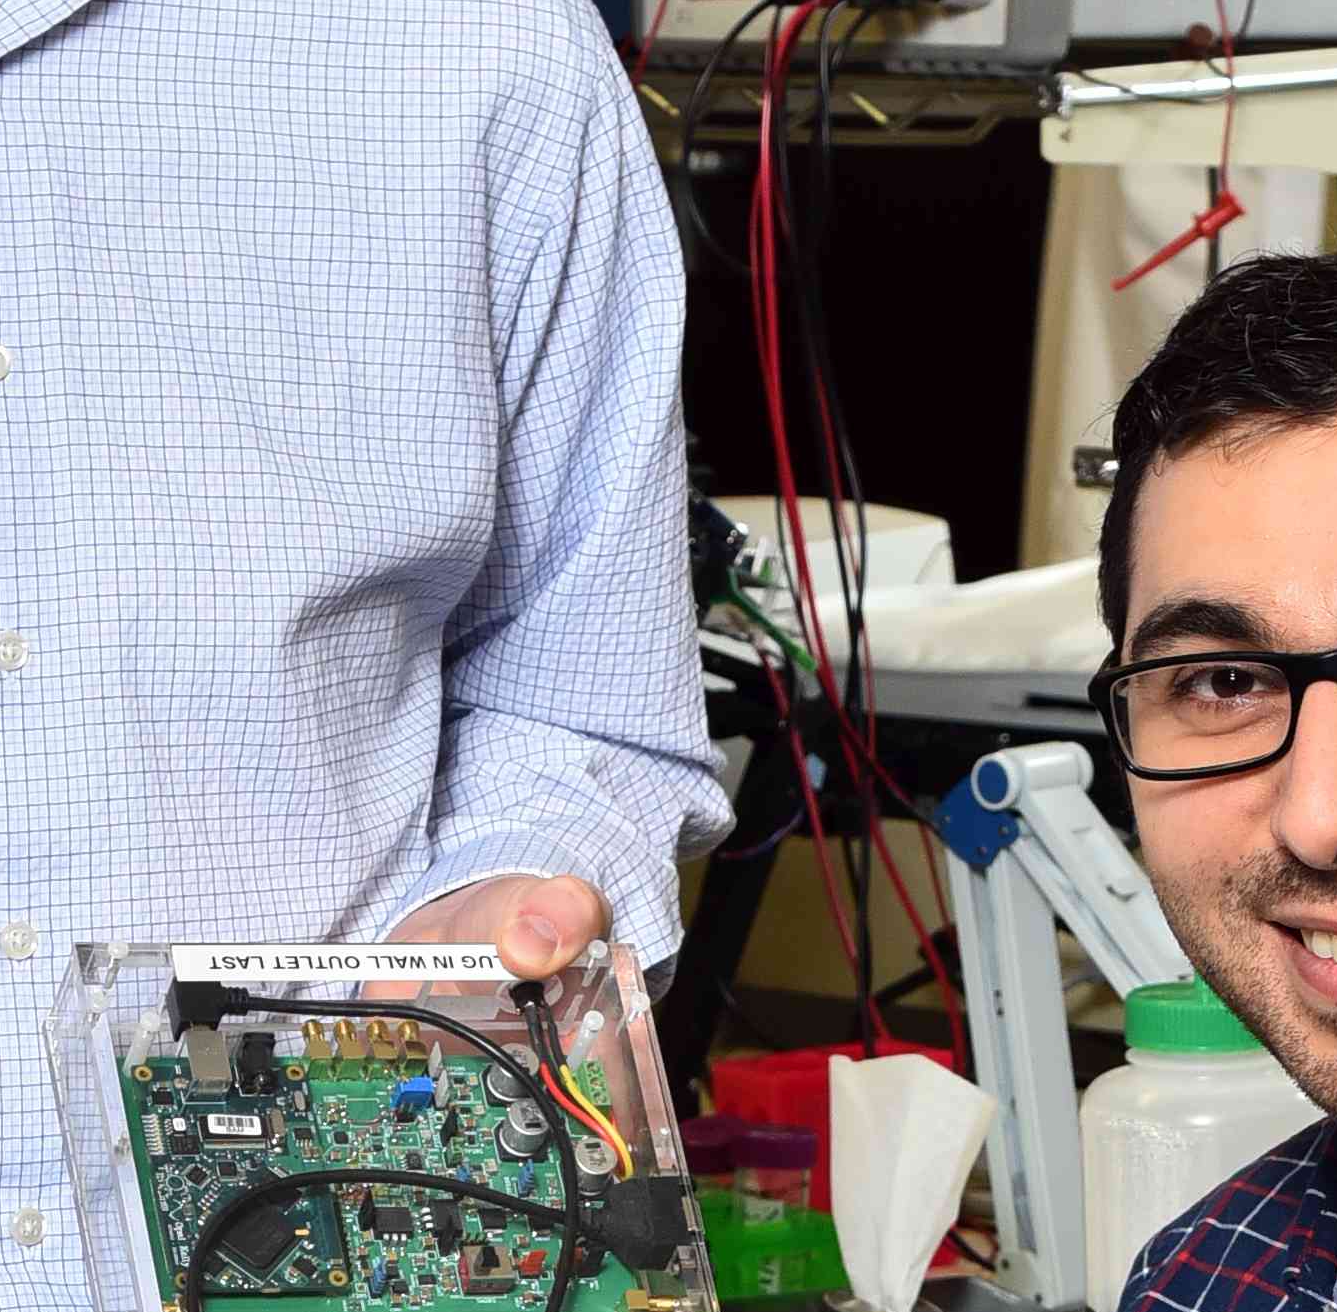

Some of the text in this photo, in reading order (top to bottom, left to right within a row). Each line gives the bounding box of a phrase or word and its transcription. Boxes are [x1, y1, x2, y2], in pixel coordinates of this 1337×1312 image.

[209, 955, 264, 970] LAST
[274, 955, 360, 969] OUTLET
[366, 955, 426, 969] WALL
[433, 955, 454, 969] IN
